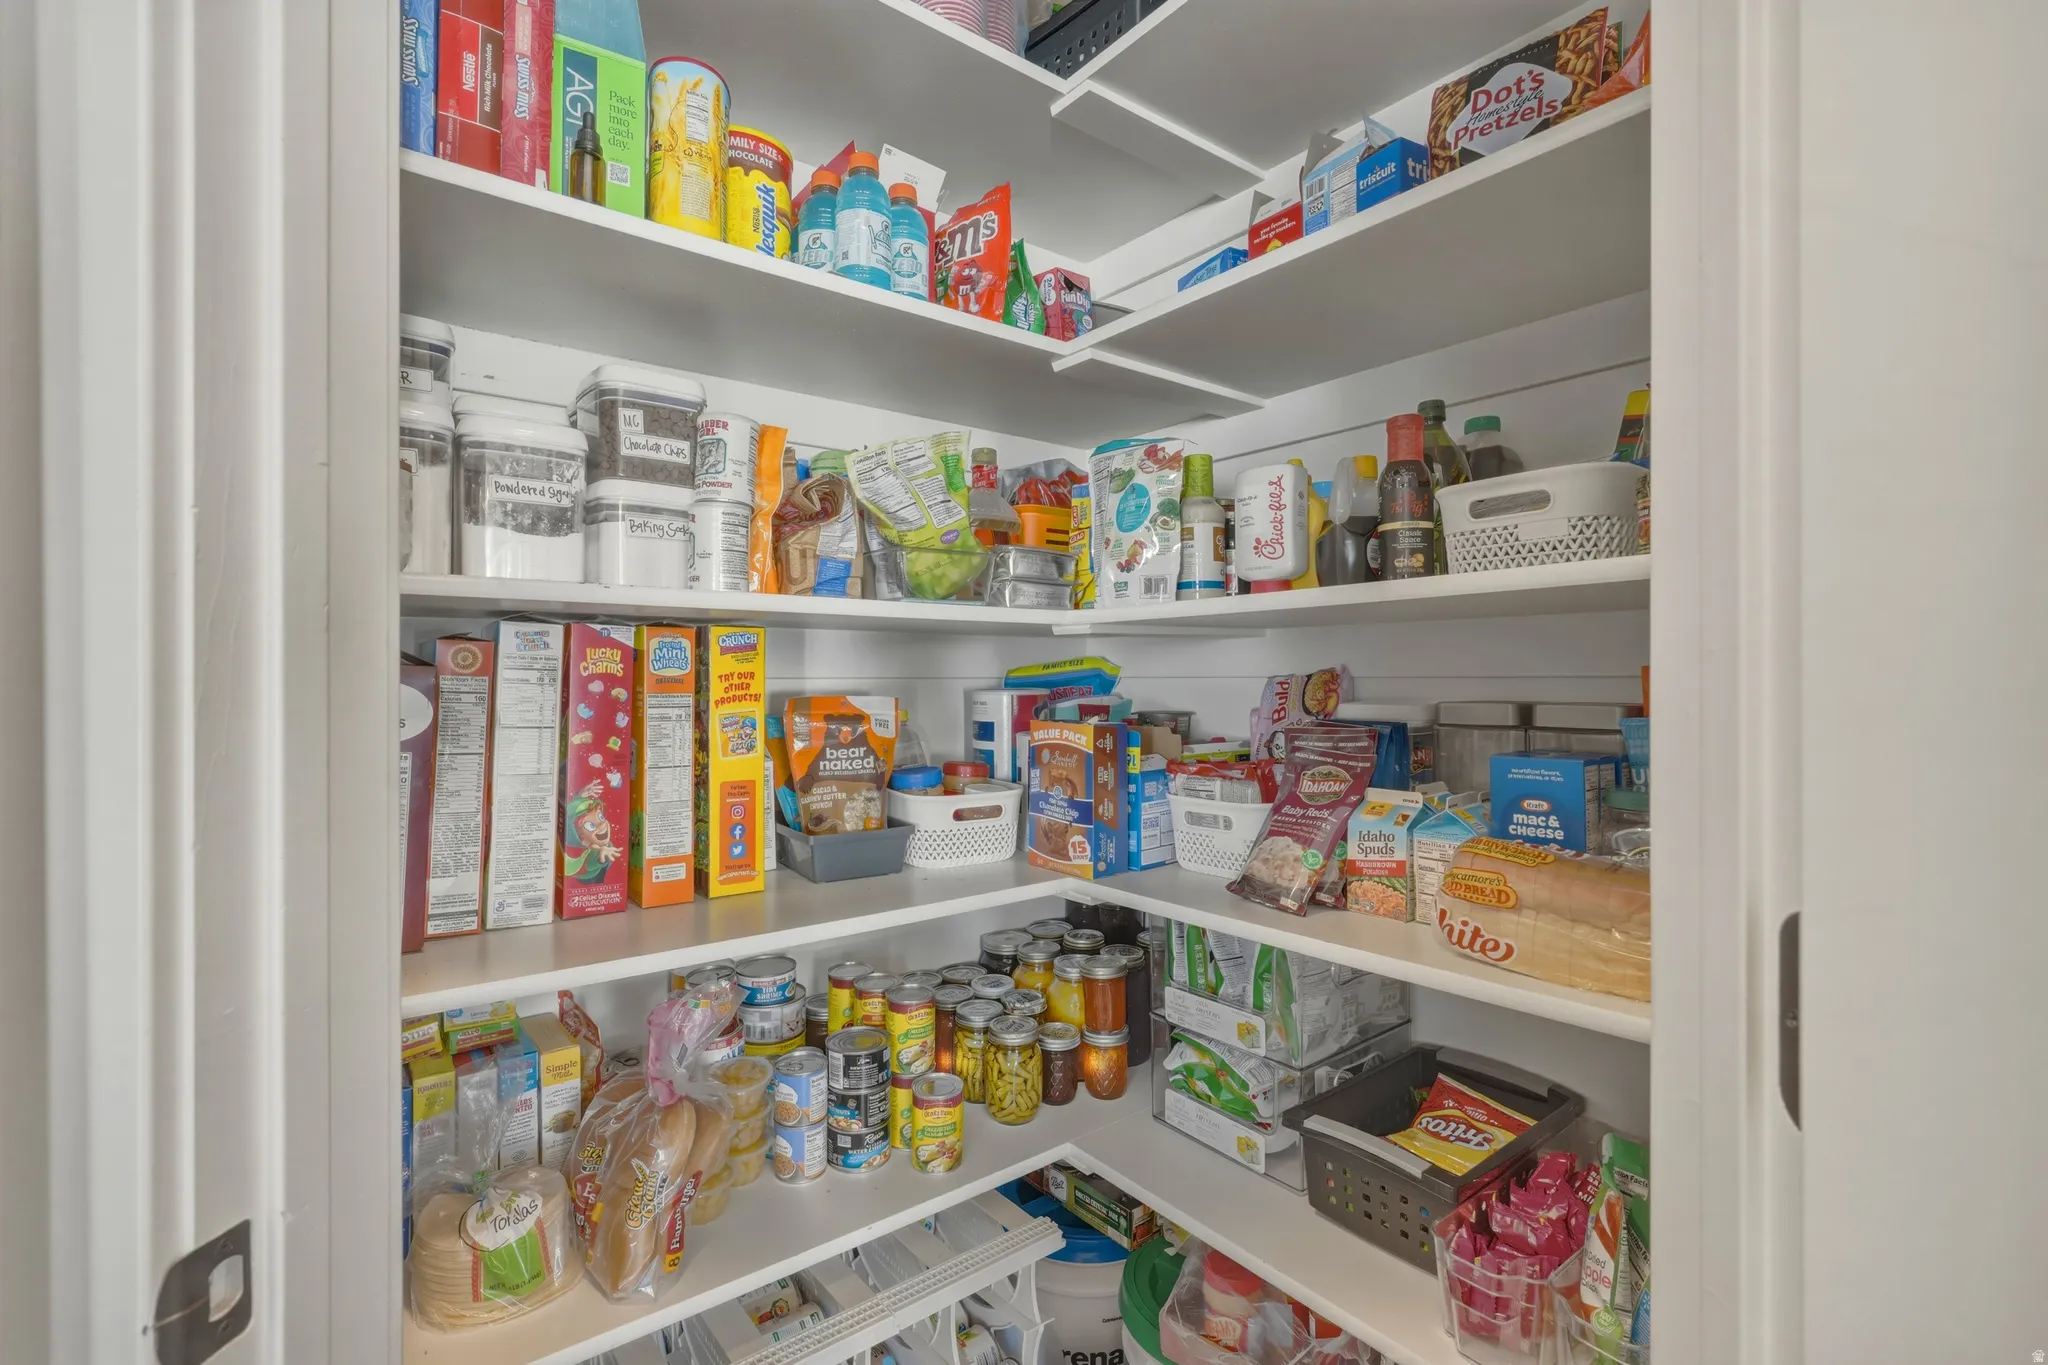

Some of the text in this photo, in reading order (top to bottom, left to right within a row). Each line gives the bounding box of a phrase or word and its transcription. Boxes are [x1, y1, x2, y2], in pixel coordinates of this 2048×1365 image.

[608, 90, 636, 108] Pack
[1471, 70, 1545, 116] Dot's
[484, 95, 492, 112] Rich
[1466, 87, 1543, 128] Homestyle
[608, 104, 637, 120] more
[608, 113, 630, 128] into
[1453, 98, 1560, 151] Pretzels
[608, 125, 634, 141] each
[608, 137, 630, 151] day.
[758, 143, 777, 158] SIZE
[728, 150, 774, 168] HOCOLATE
[1360, 162, 1396, 190] triscuit
[1061, 290, 1090, 312] Fun Dip
[624, 436, 662, 454] Chocolate
[494, 480, 546, 498] Powdered
[702, 480, 732, 488] POWDER
[630, 520, 664, 538] Baking
[1070, 531, 1084, 544] GLAD
[719, 634, 758, 646] CRUNCH
[655, 647, 685, 660] Mini
[1042, 659, 1084, 670] FAMILY SIZE
[718, 672, 756, 684] TRY OUR
[724, 683, 750, 694] OTHER
[714, 694, 761, 708] PRODUCTS!
[1034, 728, 1088, 746] VALUE PACK
[826, 747, 866, 759] bear
[820, 756, 874, 770] naked
[1301, 780, 1348, 793] IDAHOAN
[823, 792, 847, 800] BUTTER
[1039, 801, 1064, 813] Chocolate
[1065, 808, 1079, 819] Chip
[1281, 805, 1332, 818] Baby Reds
[1513, 814, 1560, 828] mac &
[1358, 830, 1395, 842] Idaho
[1070, 840, 1087, 853] 15
[1357, 843, 1395, 858] Spuds
[1418, 840, 1446, 849] Nutrition
[1463, 882, 1511, 904] BREAD
[1438, 907, 1515, 962] hite
[546, 1060, 578, 1074] Simple
[1418, 1117, 1494, 1150] Fritos
[671, 1178, 695, 1250] Hamurger
[669, 1257, 680, 1267] 8
